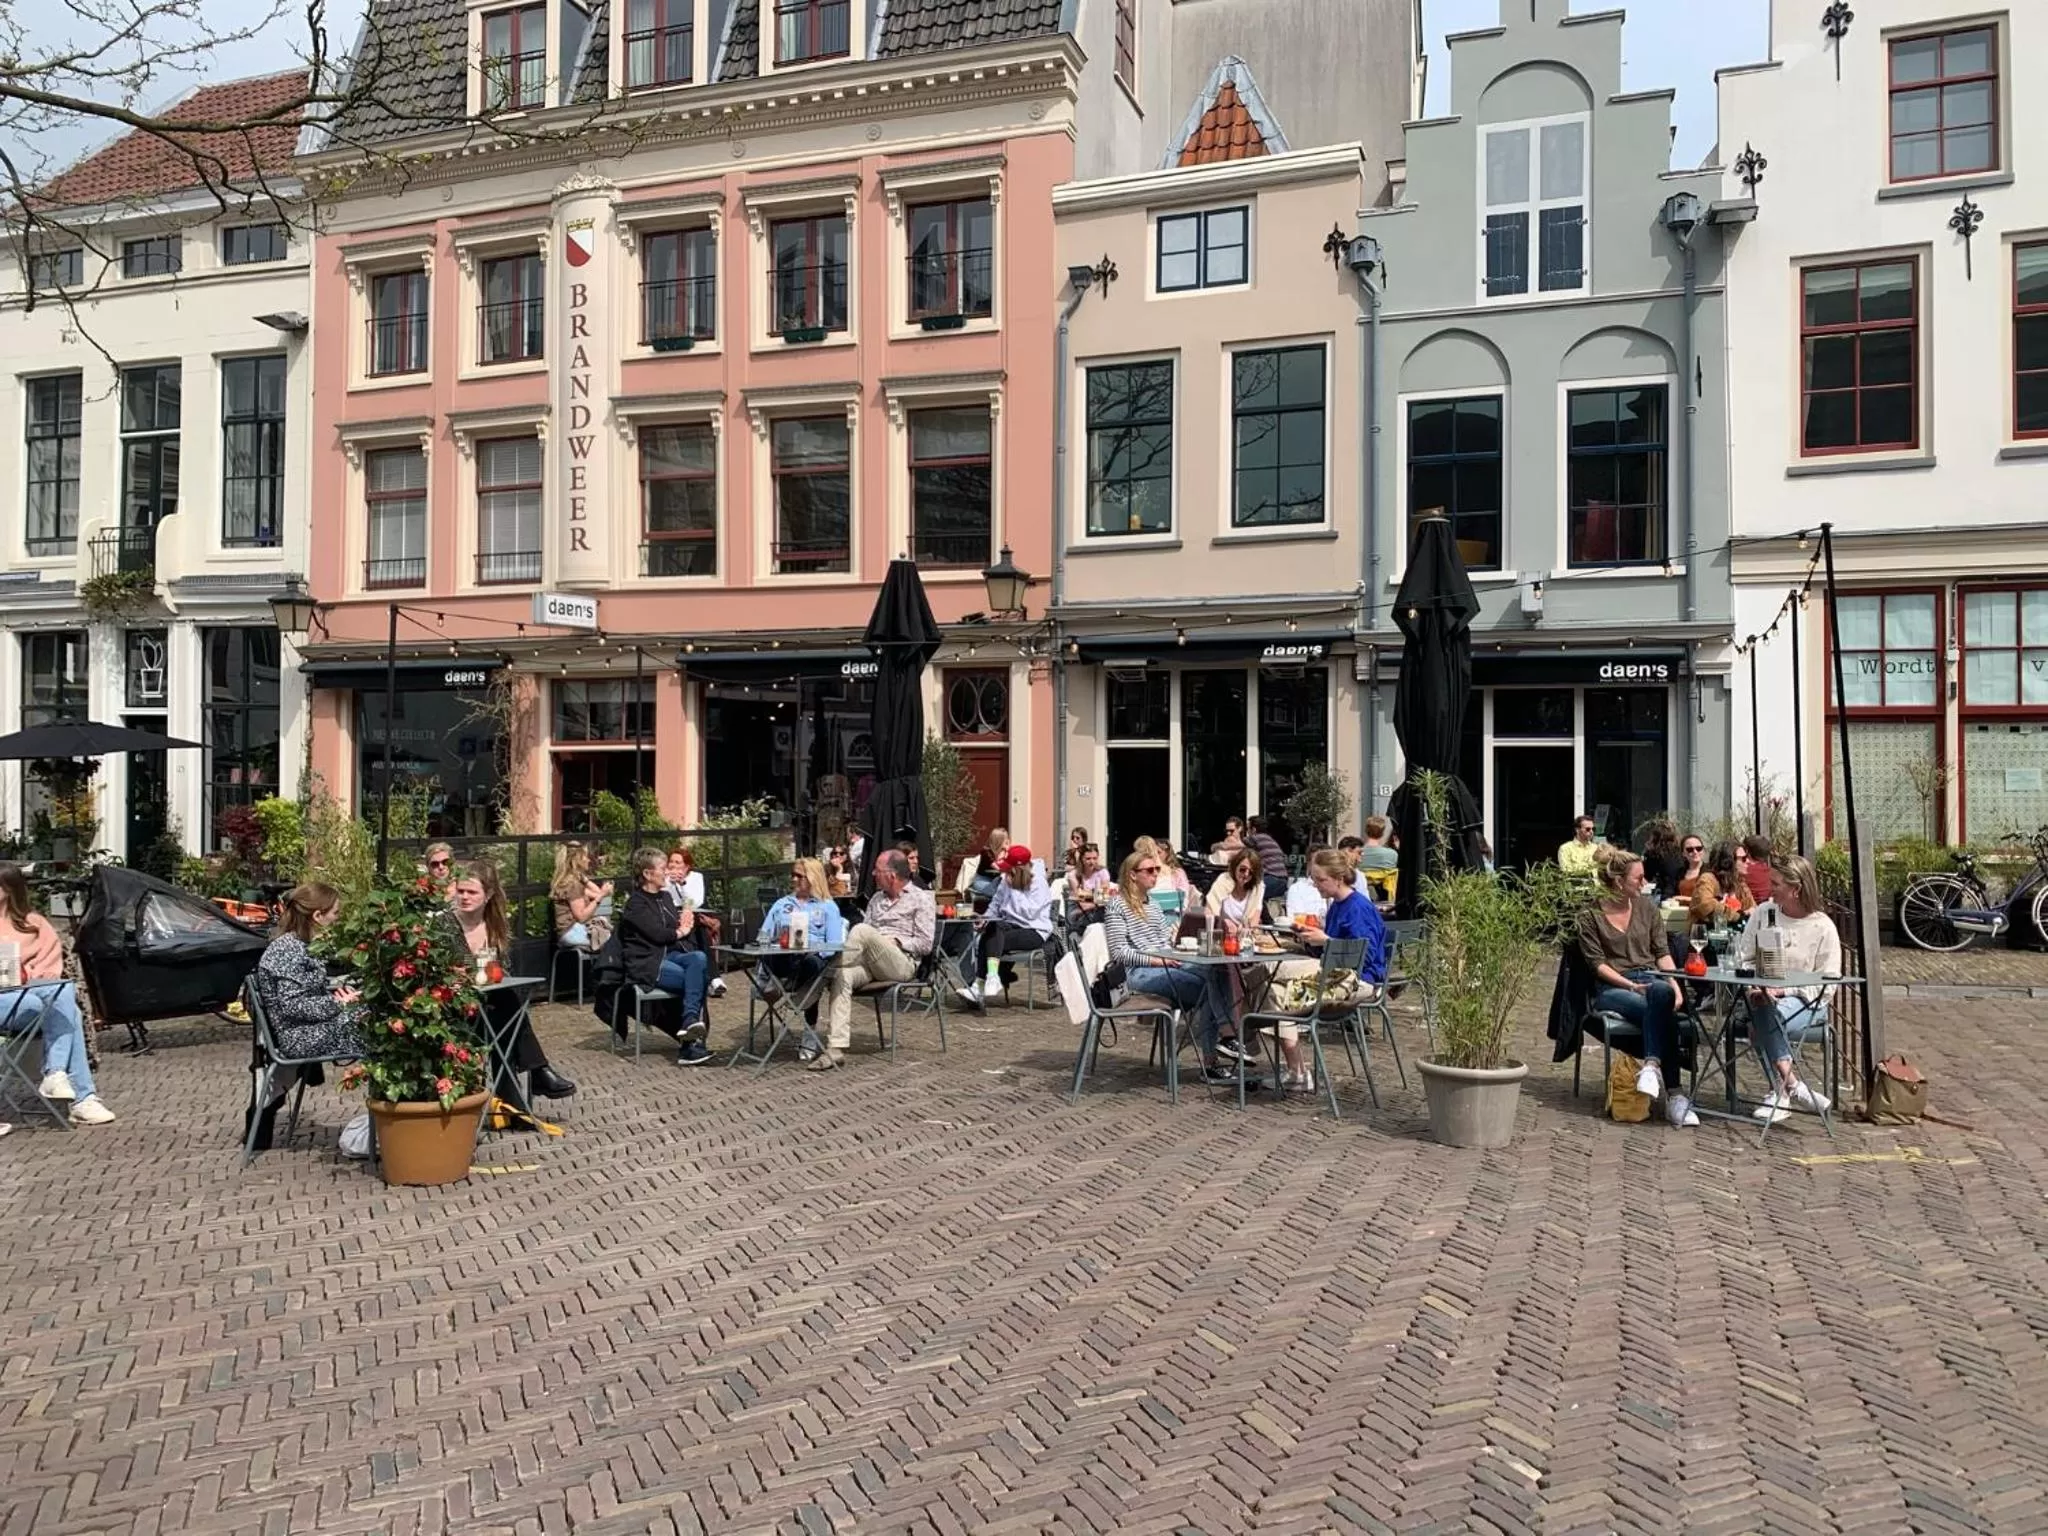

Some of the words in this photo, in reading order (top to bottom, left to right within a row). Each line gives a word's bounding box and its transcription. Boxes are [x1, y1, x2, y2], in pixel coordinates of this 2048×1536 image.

[568, 283, 596, 551] BRANDWEER
[548, 598, 594, 619] daen's
[841, 660, 879, 674] daen
[1599, 661, 1668, 678] daen's
[1859, 658, 1936, 675] Wordt
[444, 669, 486, 683] daen's
